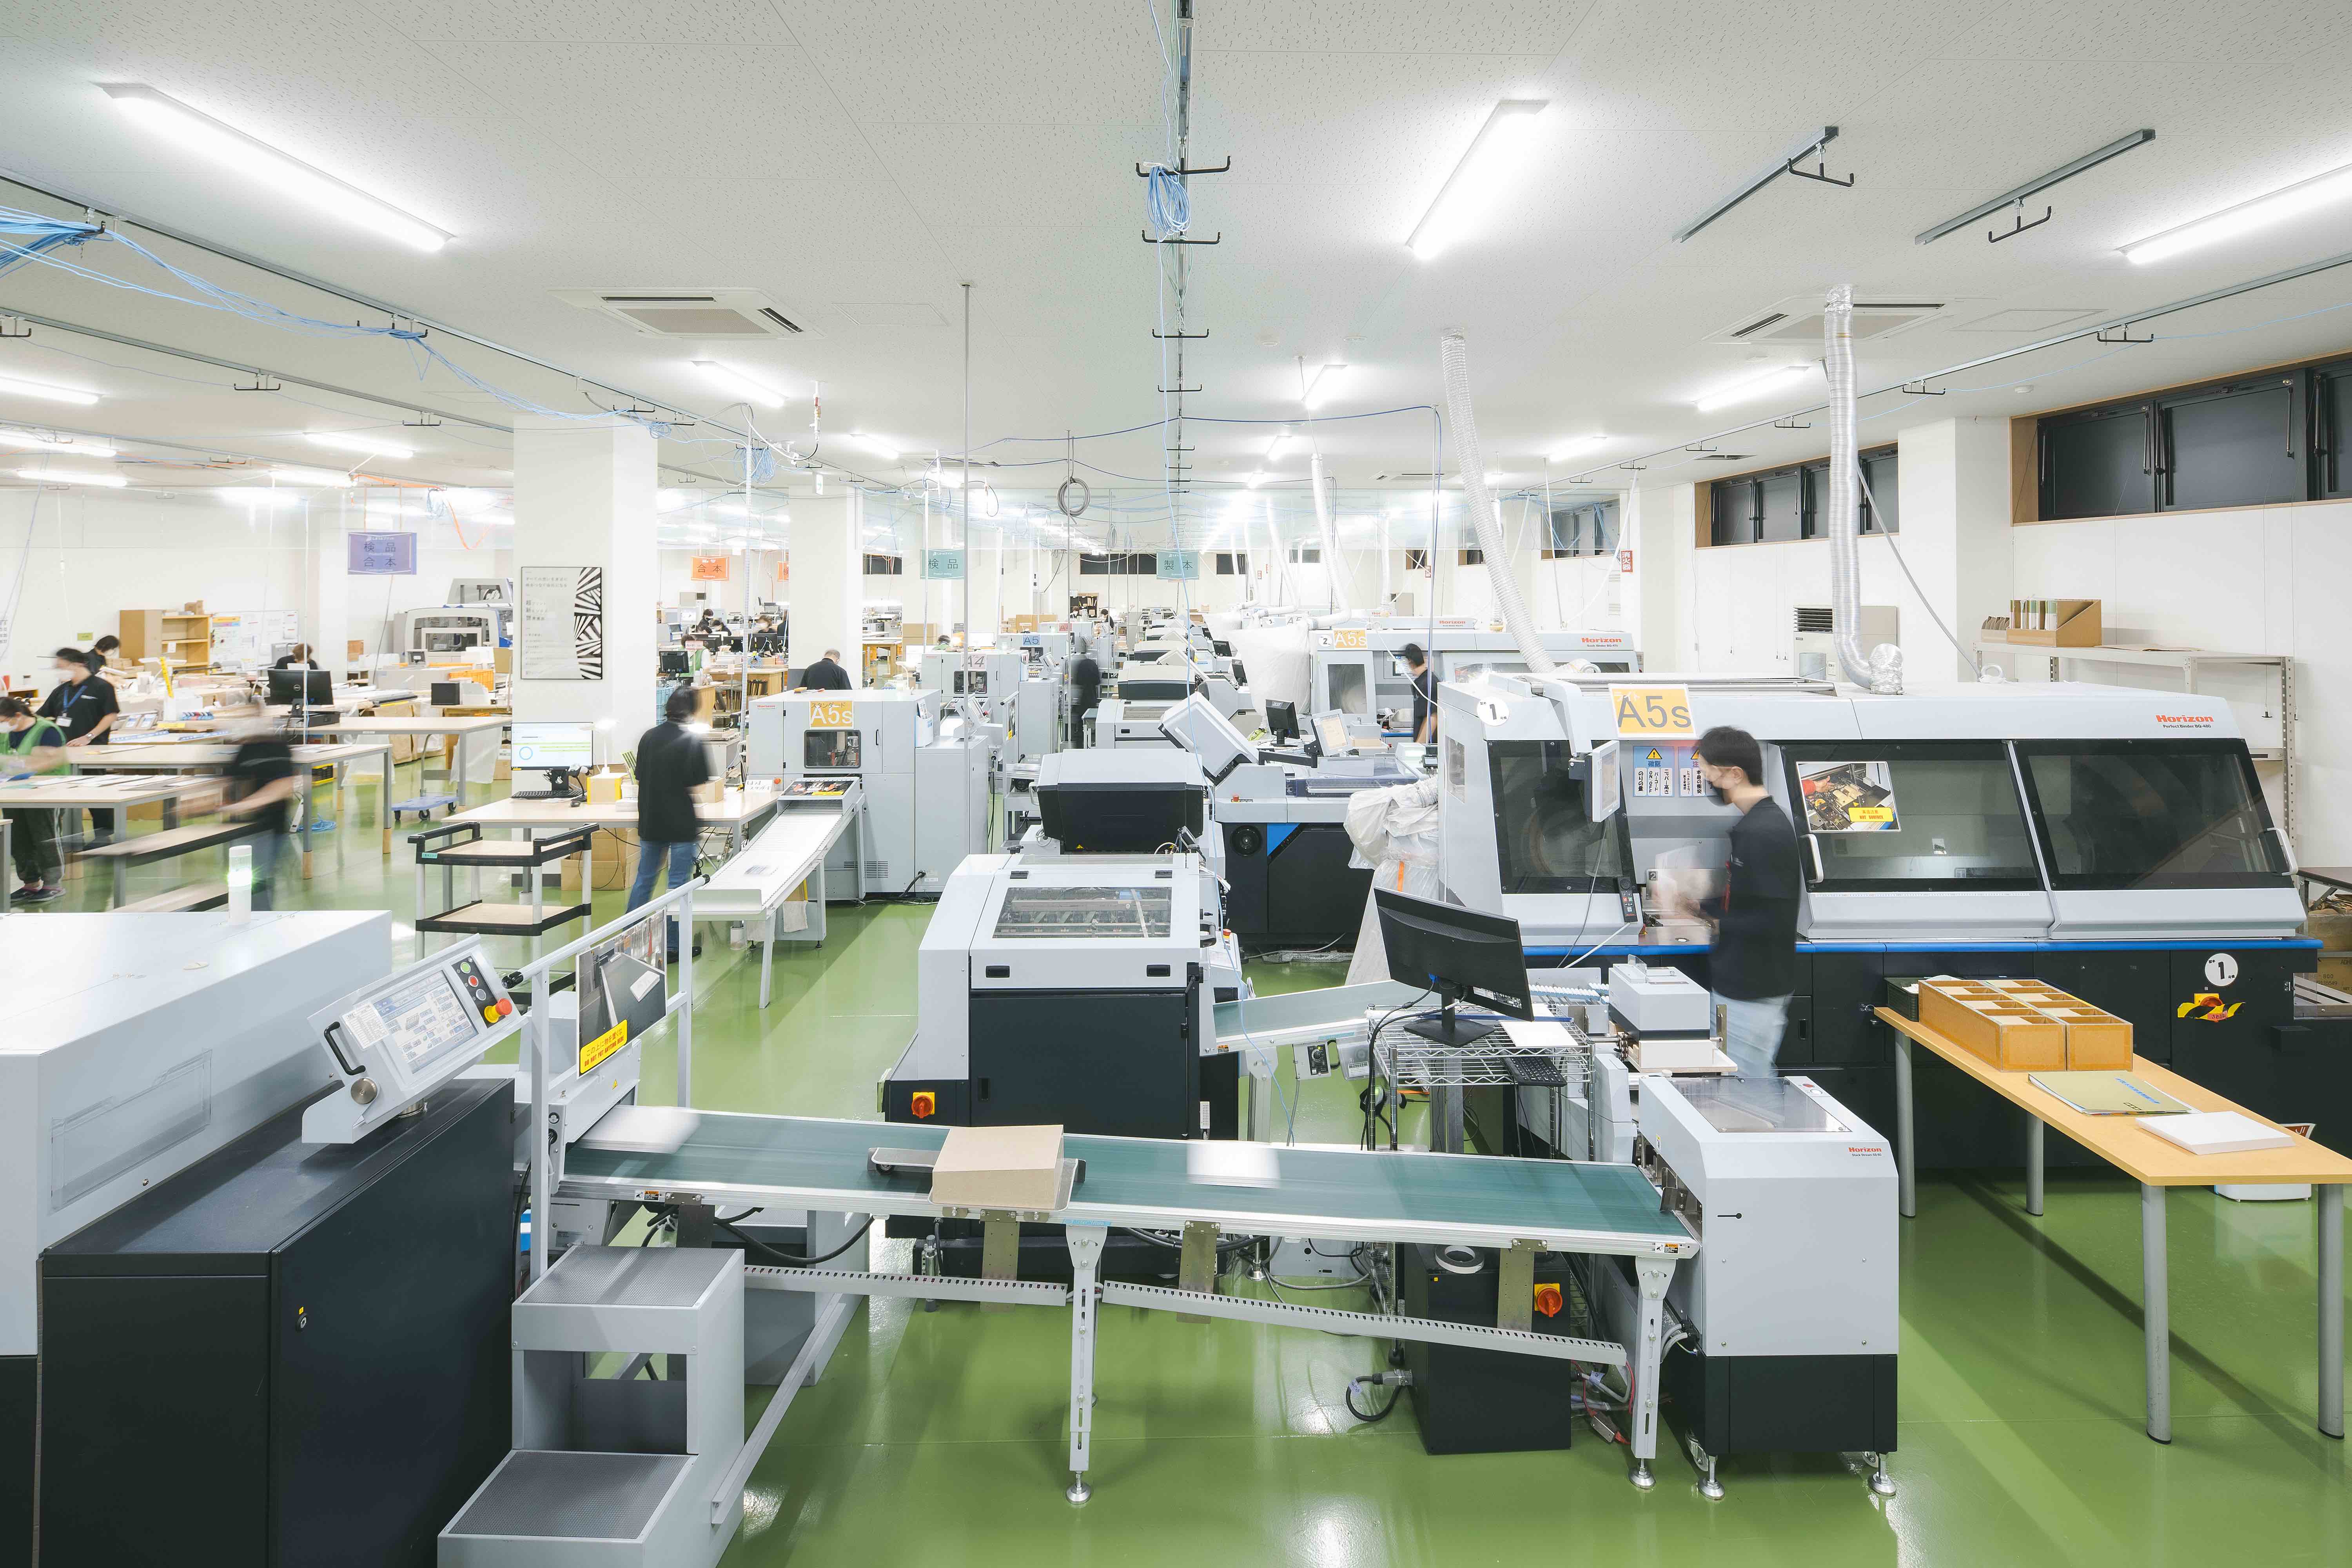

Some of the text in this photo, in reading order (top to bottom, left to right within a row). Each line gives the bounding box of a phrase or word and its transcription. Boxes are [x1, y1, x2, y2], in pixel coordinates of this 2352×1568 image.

[364, 542, 396, 552] 検品
[364, 557, 397, 567] 合本
[928, 558, 958, 569] 検品
[1164, 560, 1192, 570] 製本
[1622, 551, 1631, 572] 消火器
[697, 564, 722, 573] 合本
[1023, 636, 1039, 644] A5
[1335, 633, 1367, 646] A5s
[1614, 691, 1640, 702] ライト
[810, 705, 853, 724] A5s
[1490, 704, 1497, 720] 1
[1617, 695, 1691, 728] A5s
[2218, 962, 2225, 979] 1
[586, 1028, 622, 1057] この上に物を置くな
